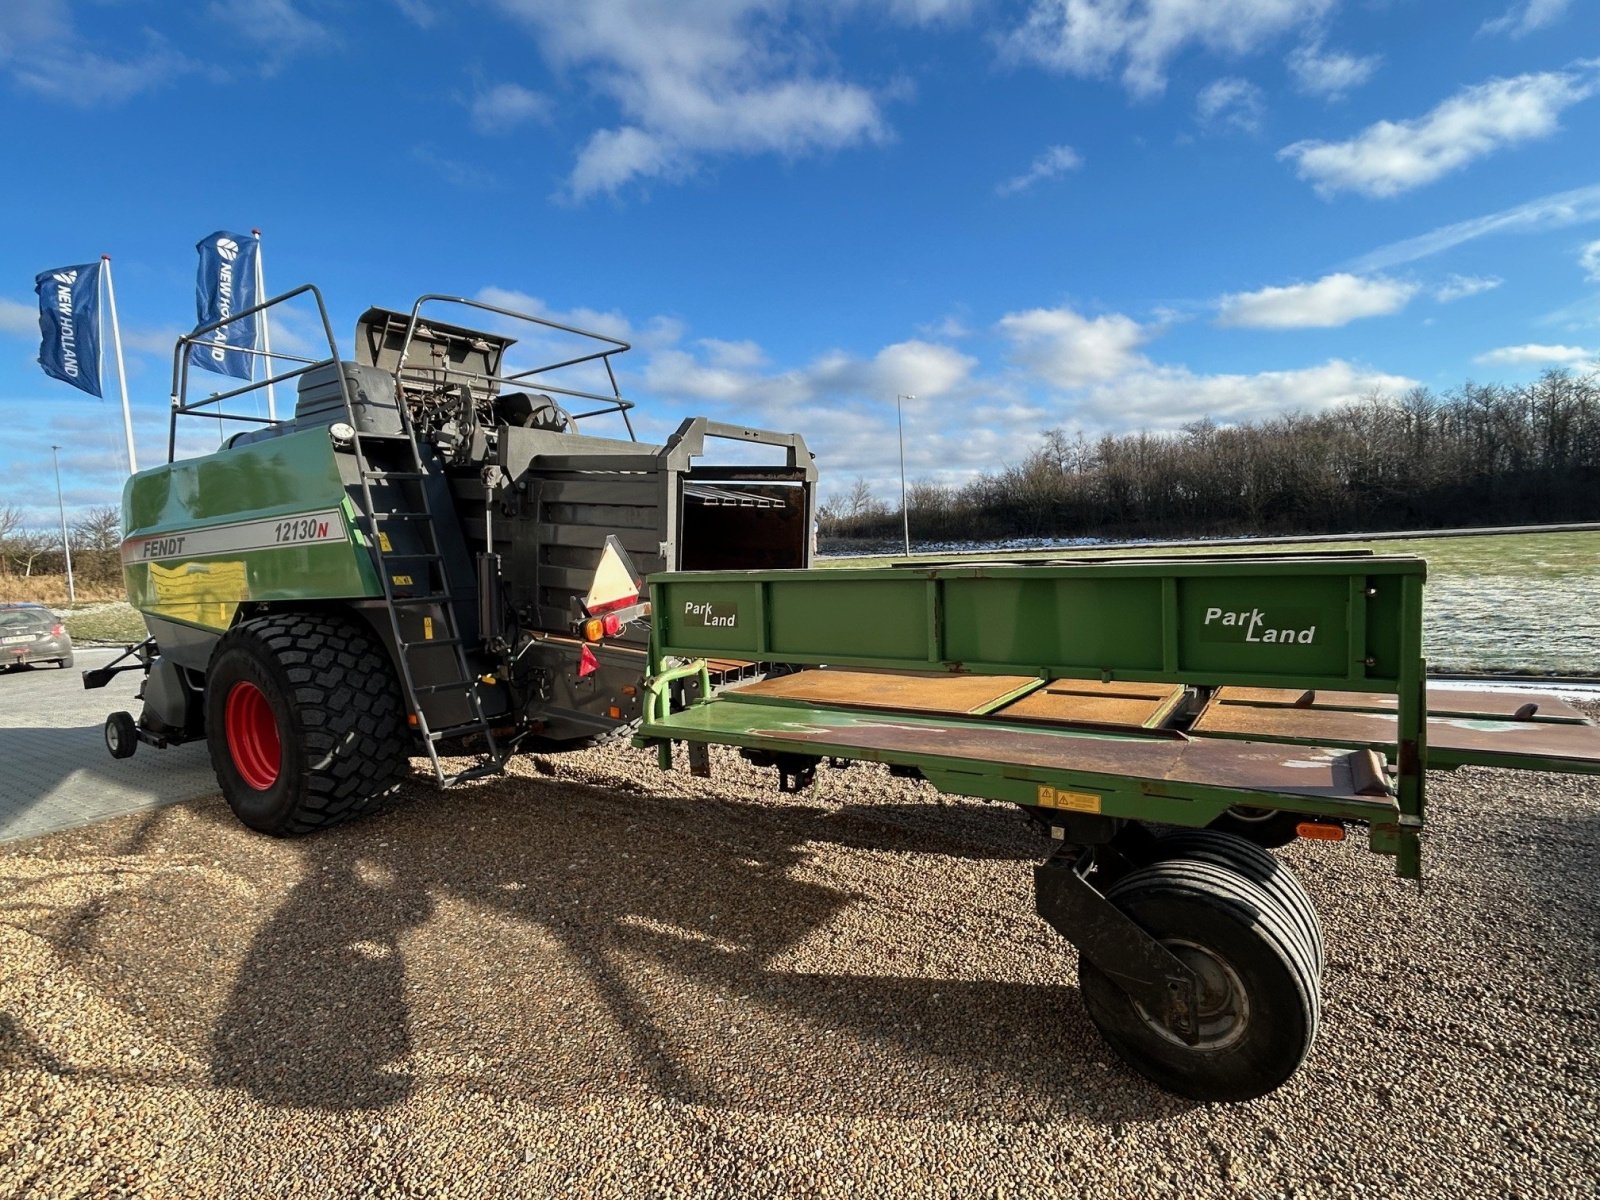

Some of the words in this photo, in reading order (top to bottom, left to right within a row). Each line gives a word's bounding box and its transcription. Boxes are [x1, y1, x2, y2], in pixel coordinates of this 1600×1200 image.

[219, 262, 232, 297] NEW
[58, 284, 73, 317] NEW
[212, 297, 231, 361] HOAND
[60, 315, 79, 378] HOLLAND
[275, 519, 328, 542] 12130N
[143, 537, 185, 558] FENDT
[684, 601, 712, 614] Park
[1204, 607, 1265, 626] Park
[704, 614, 736, 627] Land
[1245, 625, 1315, 644] Land
